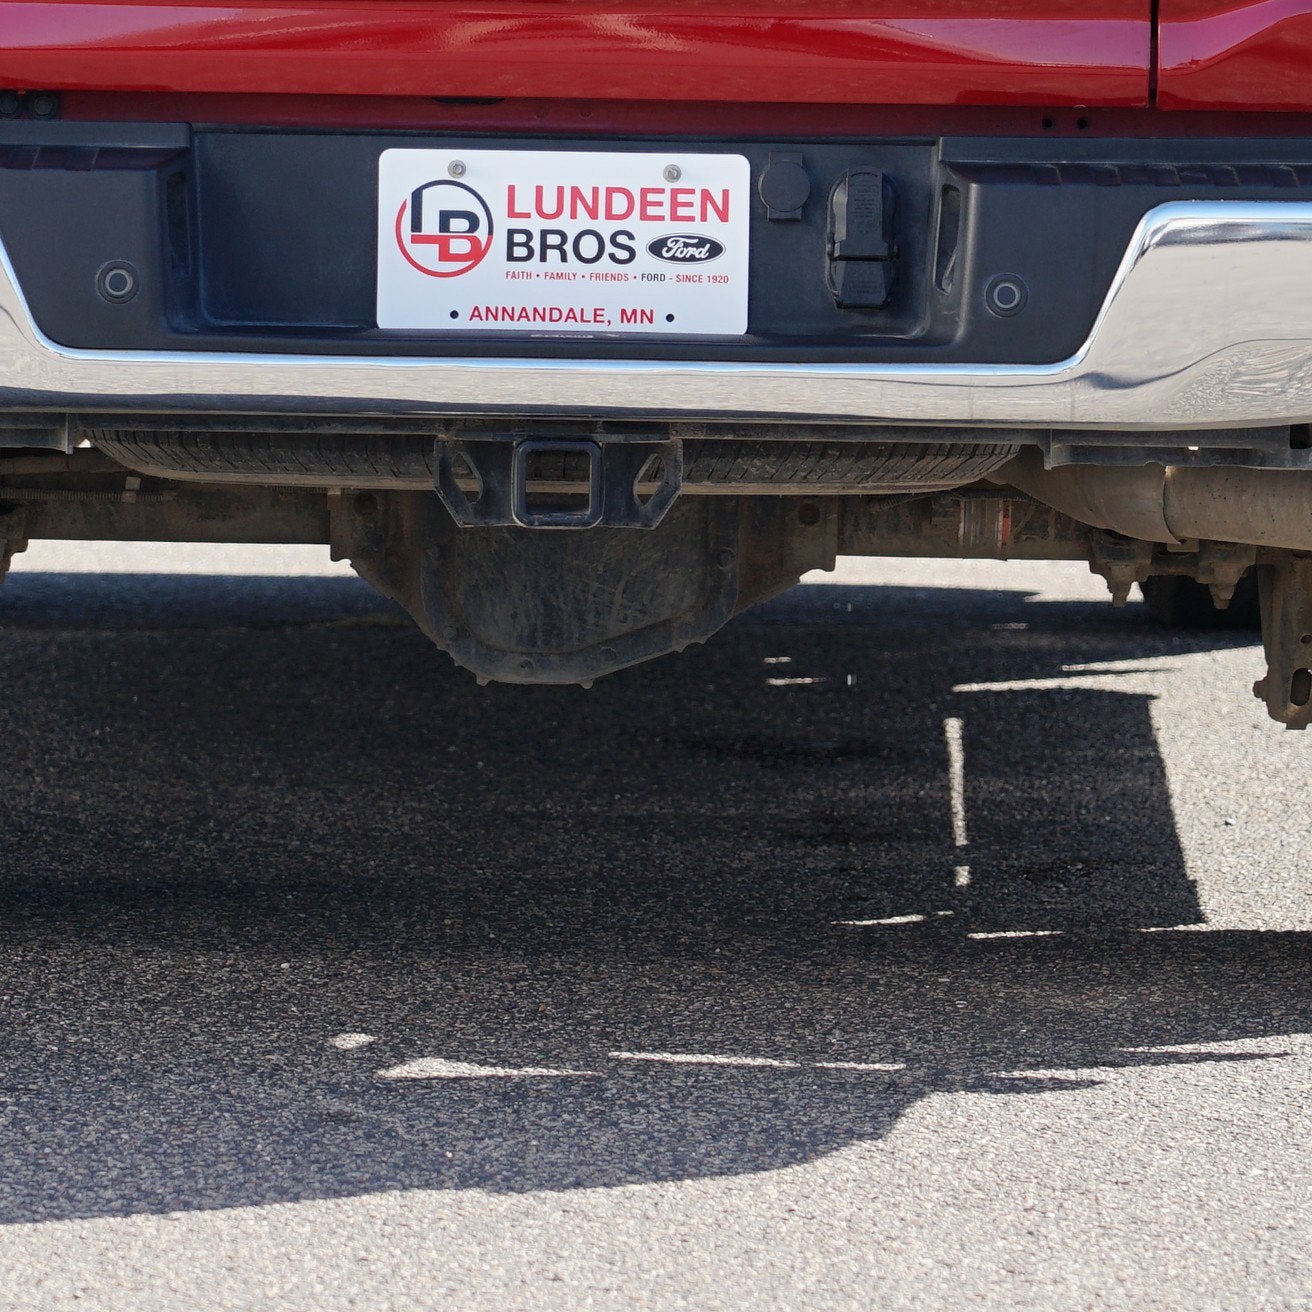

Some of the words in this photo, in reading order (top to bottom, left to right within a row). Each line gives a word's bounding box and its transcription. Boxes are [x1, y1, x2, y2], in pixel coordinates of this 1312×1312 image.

[506, 184, 731, 224] LUNDEEN
[505, 228, 638, 265] BROS
[661, 237, 712, 259] Ford
[505, 270, 533, 281] FAITH
[544, 271, 578, 282] FAMILY
[589, 272, 630, 283] FRIENDS
[640, 273, 667, 283] FORD
[675, 274, 704, 284] SINCE
[706, 274, 730, 285] 1920
[468, 305, 612, 327] ANNANDALE,
[620, 308, 655, 325] MN
